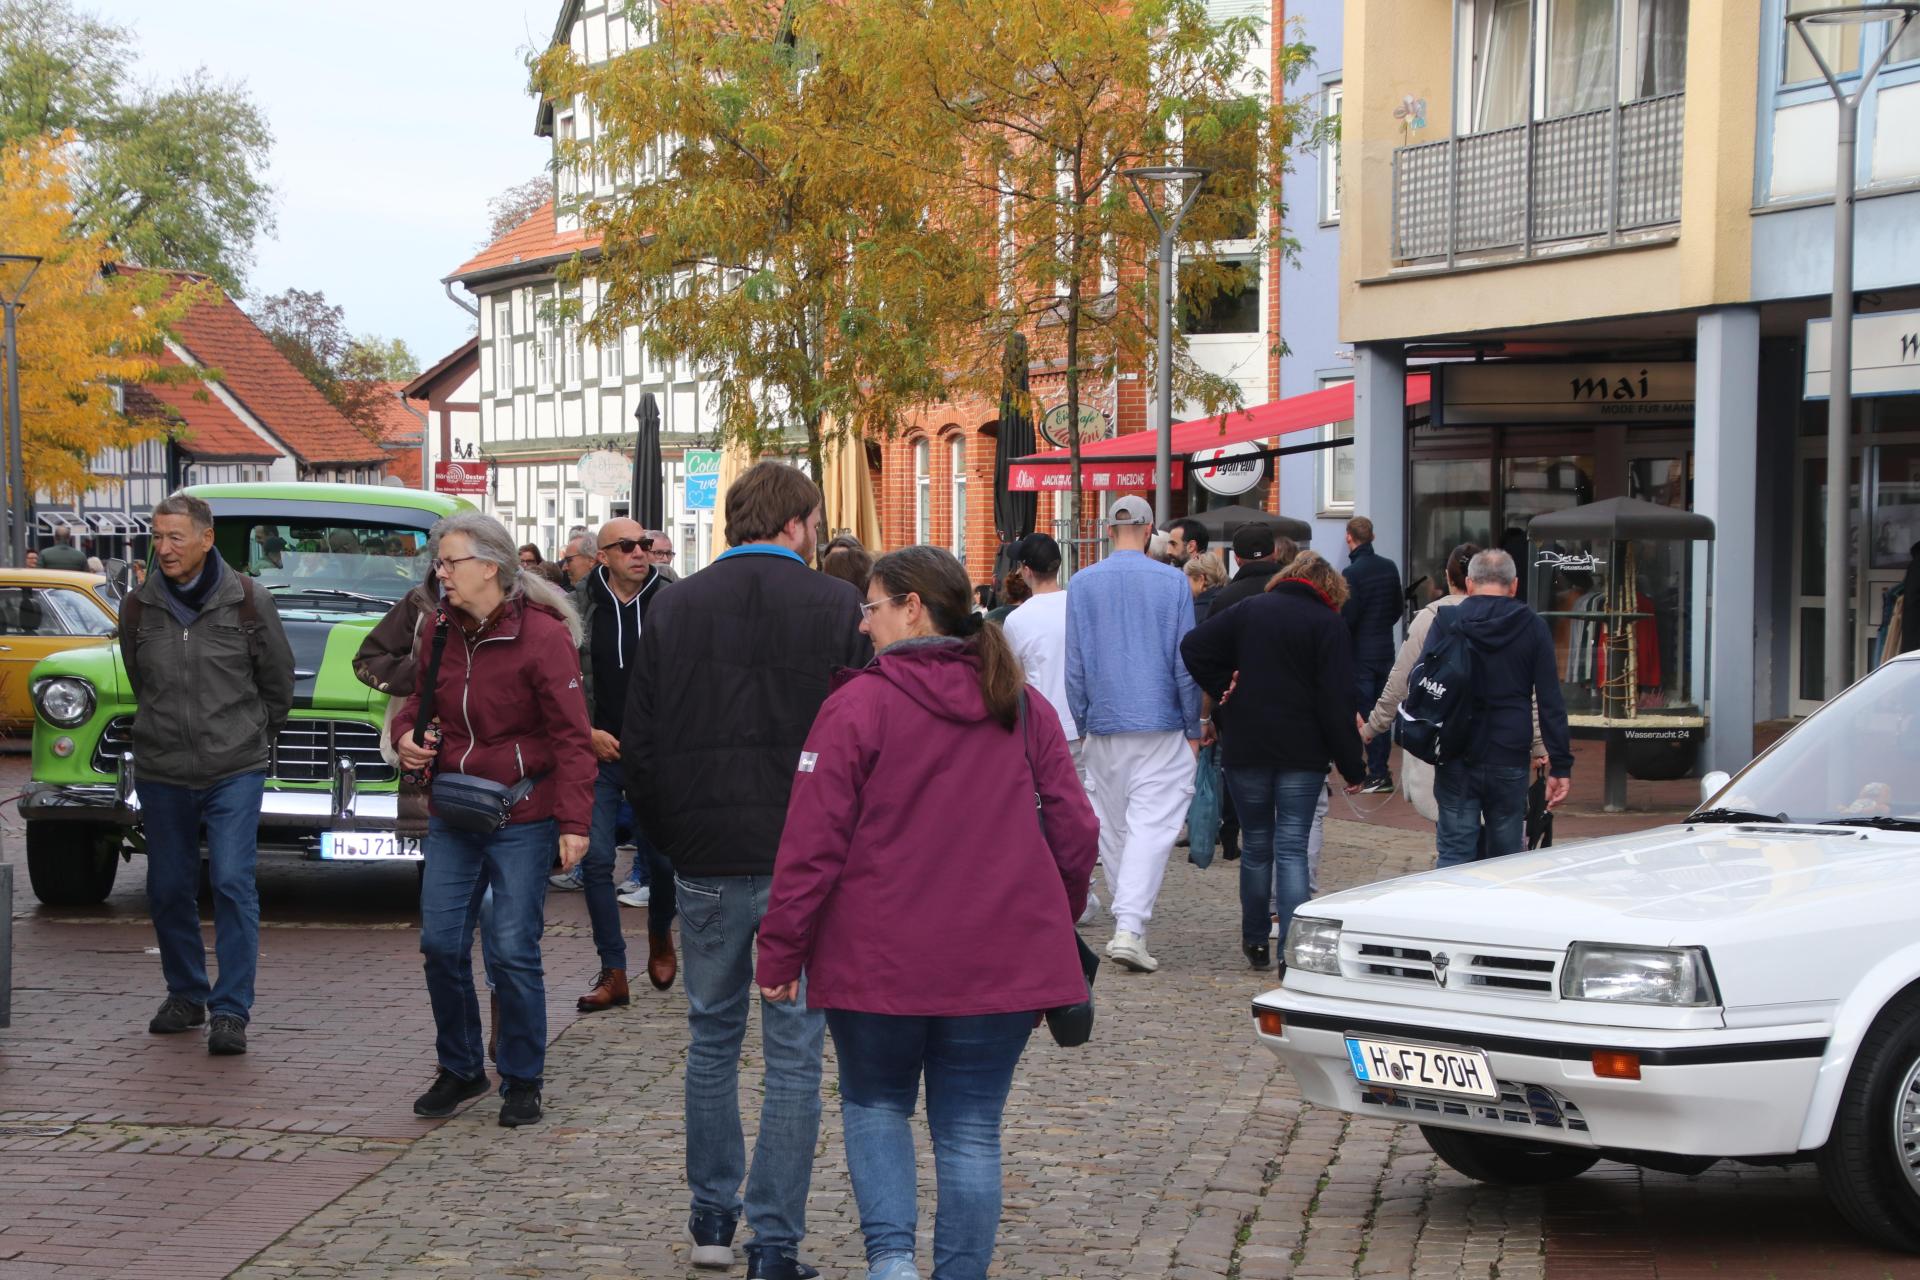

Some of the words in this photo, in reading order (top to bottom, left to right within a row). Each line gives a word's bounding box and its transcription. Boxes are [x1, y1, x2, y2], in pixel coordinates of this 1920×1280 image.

[1569, 369, 1648, 401] mai
[1601, 404, 1634, 414] MODE
[1117, 473, 1145, 486] TIMEZONE
[1625, 730, 1677, 739] Wasserzucht
[1678, 730, 1690, 739] 24
[334, 838, 345, 855] H
[360, 838, 369, 855] J
[375, 838, 424, 856] 7112
[1369, 1046, 1389, 1078] H
[1399, 1049, 1434, 1083] FZ
[1433, 1054, 1483, 1090] 90H
